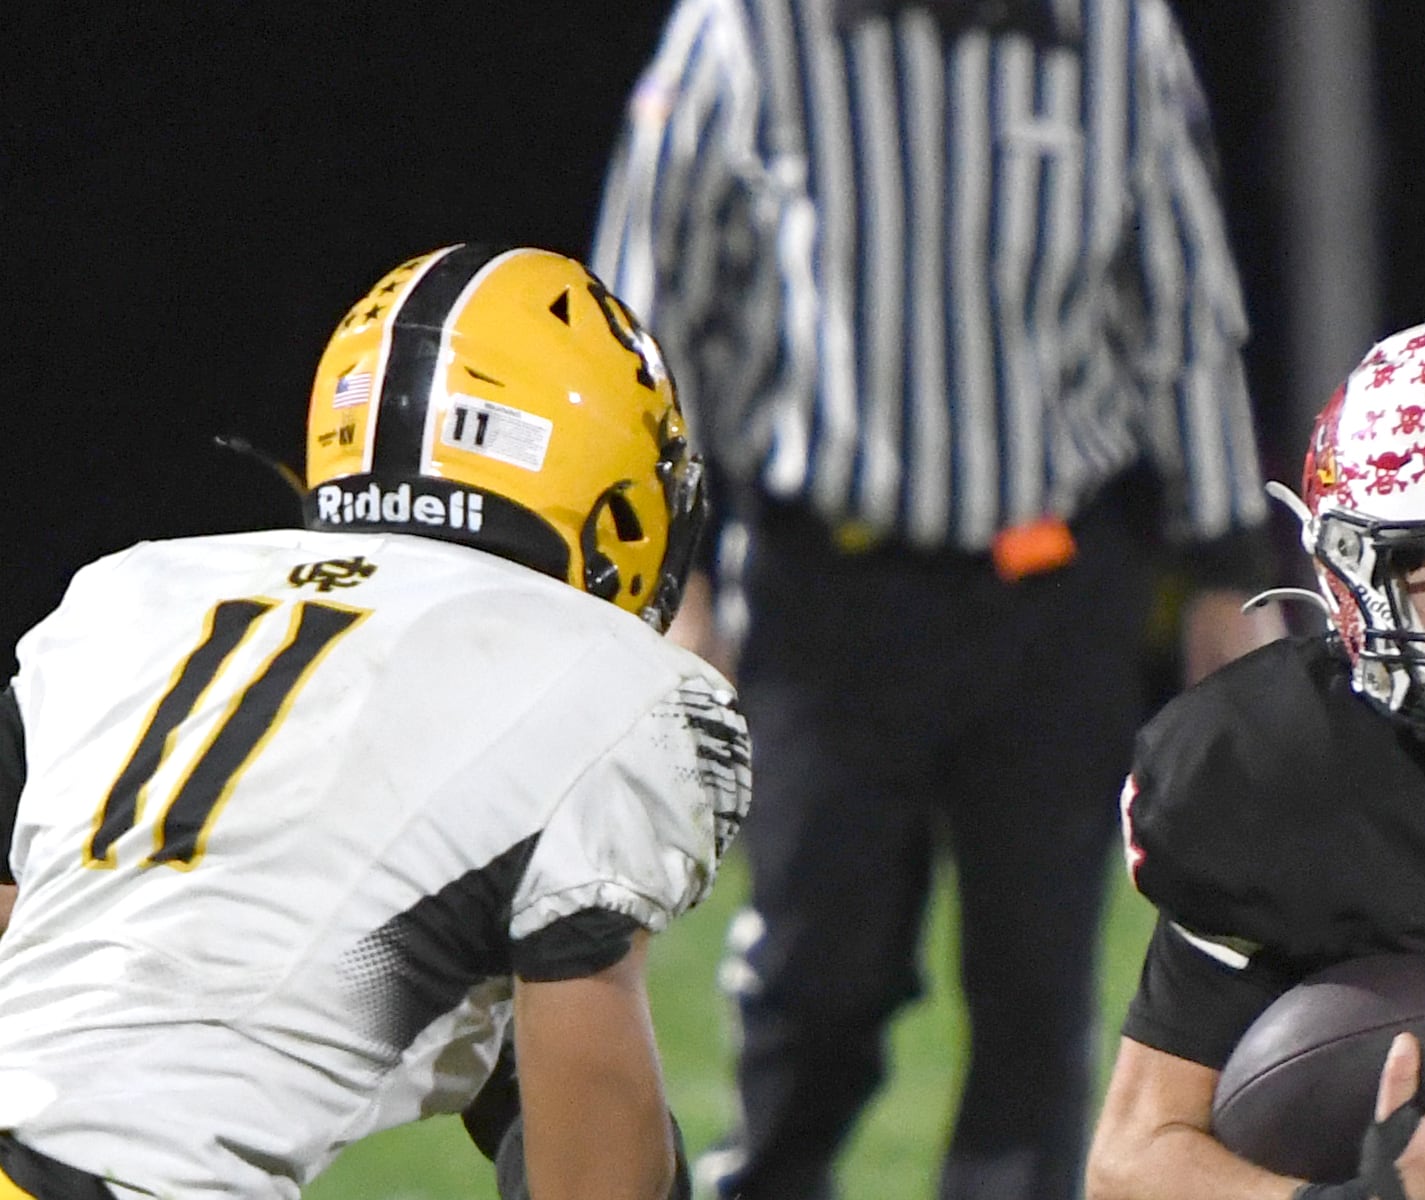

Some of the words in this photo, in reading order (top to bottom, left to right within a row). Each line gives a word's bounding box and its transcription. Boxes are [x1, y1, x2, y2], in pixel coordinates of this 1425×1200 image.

[453, 407, 489, 446] 11
[318, 483, 483, 533] Riddell
[81, 595, 376, 872] 11
